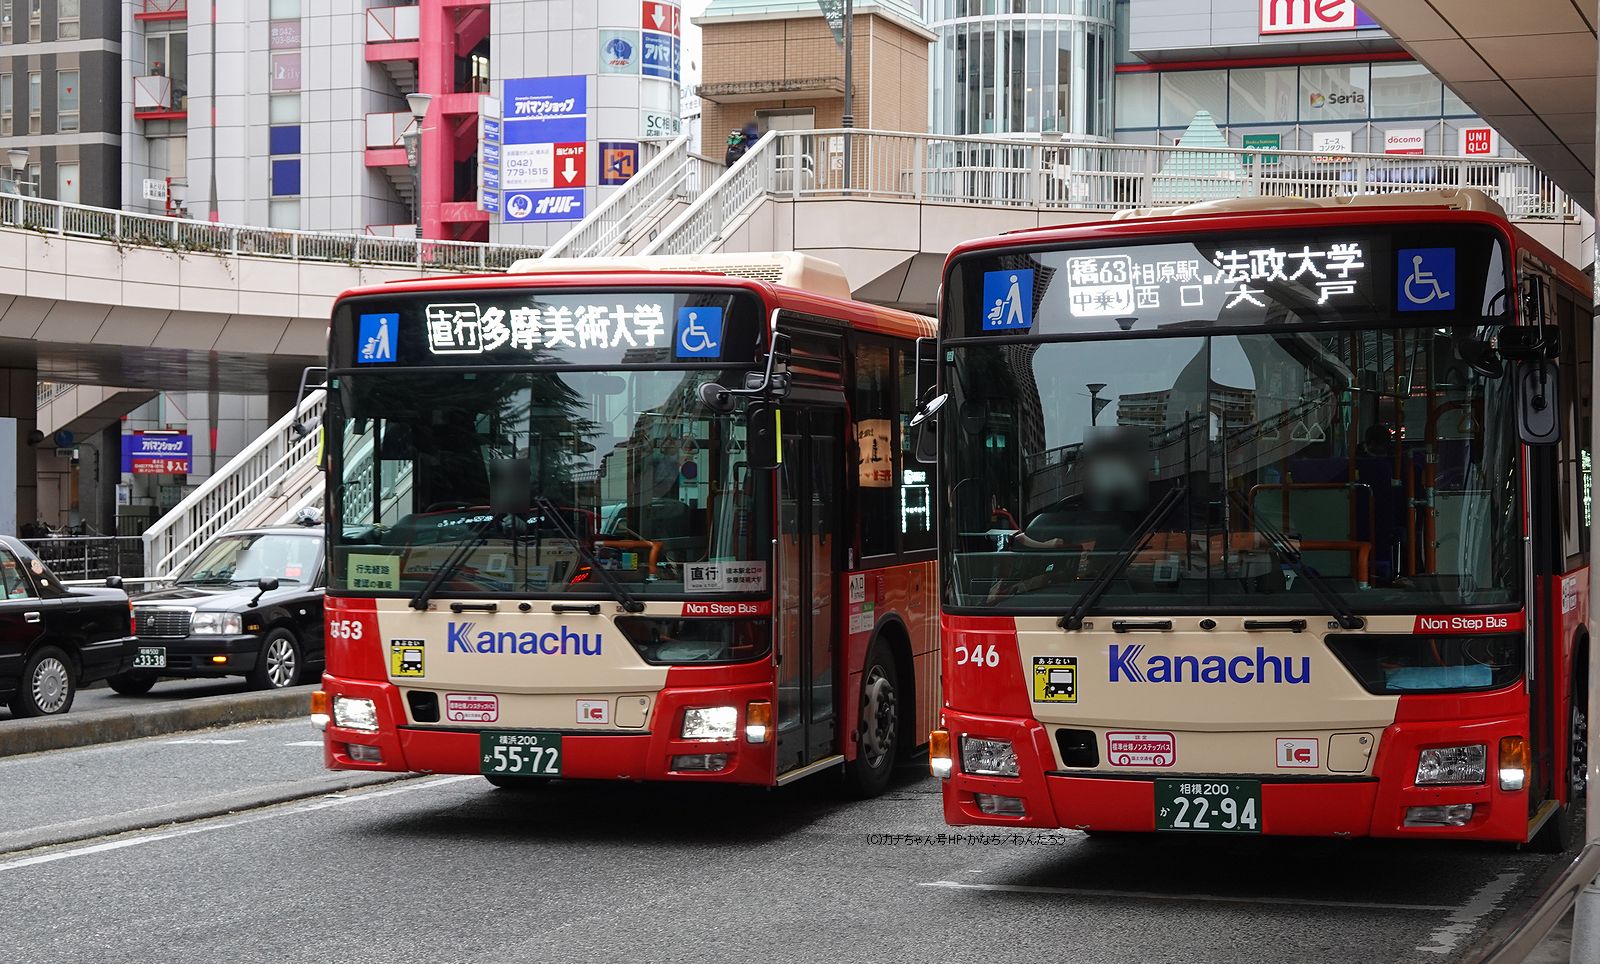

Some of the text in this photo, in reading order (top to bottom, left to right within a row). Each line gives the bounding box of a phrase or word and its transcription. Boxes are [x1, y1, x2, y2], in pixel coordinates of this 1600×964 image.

[1328, 91, 1365, 105] Seria
[514, 98, 575, 115] アパマンショップ
[1324, 137, 1340, 145] エース
[1387, 136, 1422, 144] docomo
[1468, 132, 1487, 142] UNI
[1468, 142, 1488, 153] QLO
[506, 159, 533, 168] (042)
[506, 167, 549, 177] 779-1515
[535, 196, 581, 214] オリバー
[1071, 243, 1365, 285] 橋63 相原駅 法政大学
[1073, 289, 1131, 312] 中乗り
[430, 304, 665, 351] 直行 多摩美術大学
[690, 567, 719, 581] 直行
[686, 603, 758, 615] Non Step Bus
[1421, 616, 1508, 630] Non Step Bus
[447, 621, 603, 656] Kanachu
[955, 644, 1000, 668] つ46
[1038, 657, 1071, 665] あぶない
[1108, 644, 1311, 685] Kanachu
[499, 735, 538, 745] 横浜200
[1112, 743, 1171, 751] 標準仕様ノンステップバス
[483, 745, 559, 773] か 55-72
[1179, 783, 1229, 795] 相模200
[1159, 796, 1257, 830] か 22-94
